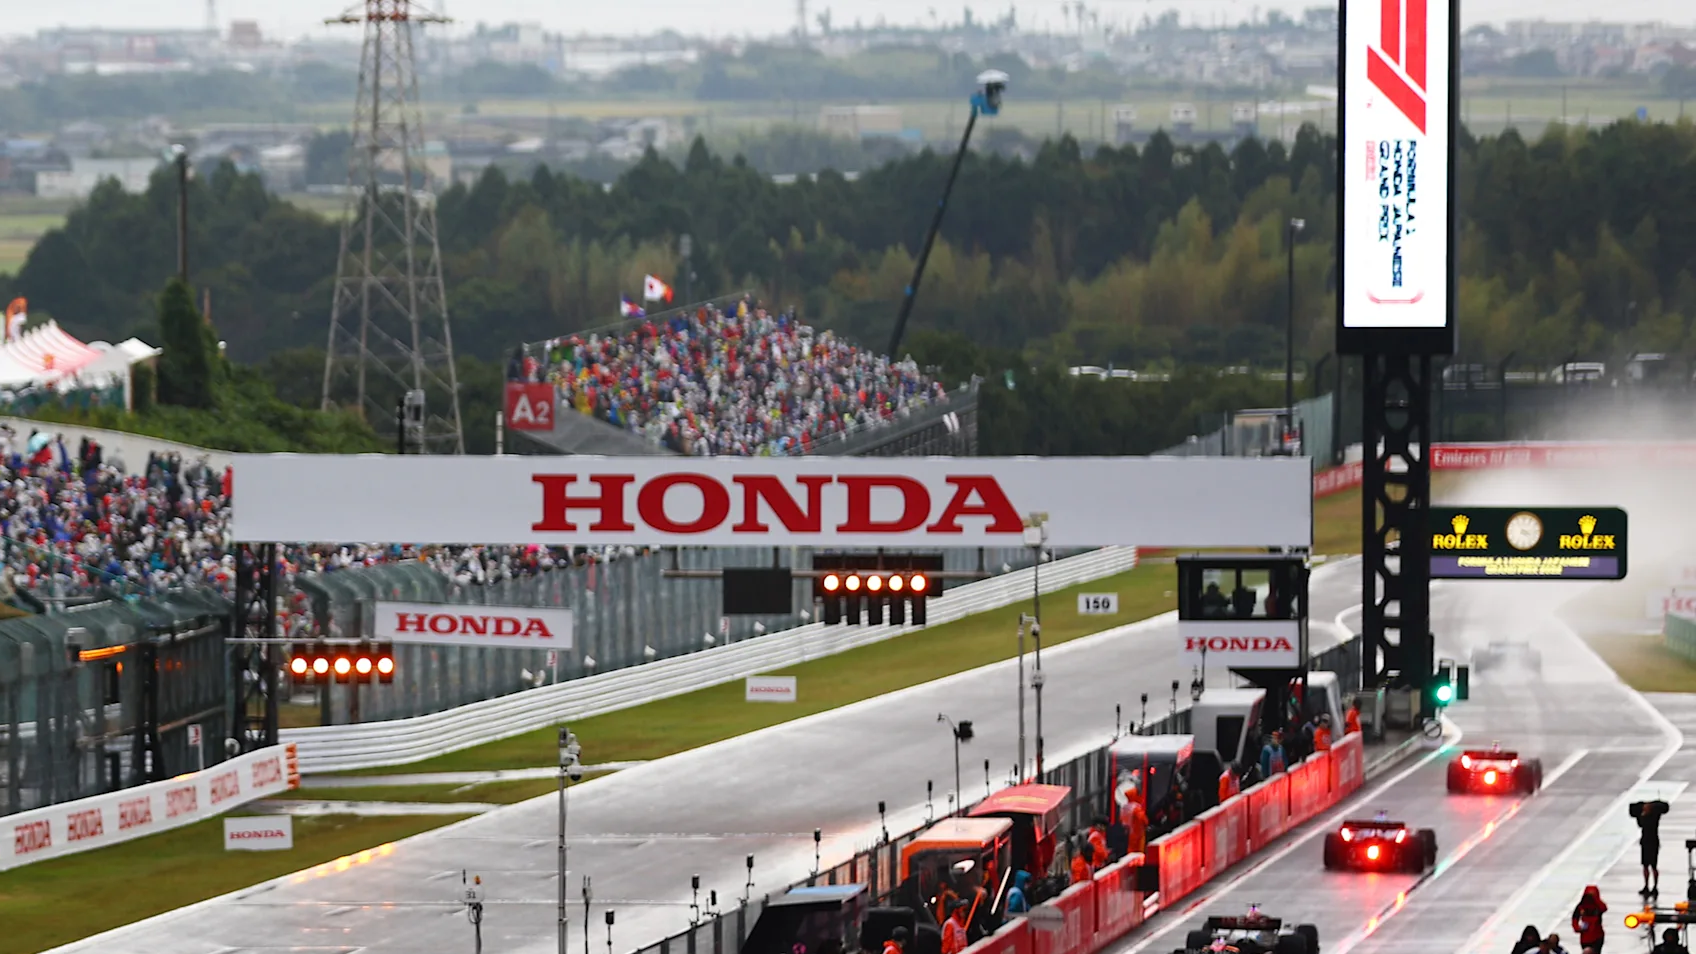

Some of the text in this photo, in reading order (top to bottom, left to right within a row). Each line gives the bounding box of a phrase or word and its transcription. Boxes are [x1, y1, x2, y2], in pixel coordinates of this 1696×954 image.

[512, 393, 550, 424] A2
[531, 473, 1026, 534] HONDA
[1432, 534, 1488, 549] ROLEX
[1559, 535, 1615, 549] ROLEX
[1084, 597, 1110, 611] 150
[395, 612, 553, 639] HONDA
[1185, 637, 1293, 652] HONDA
[67, 809, 103, 841] HONDA
[229, 829, 286, 840] HONDA
[15, 821, 52, 854] HONDA
